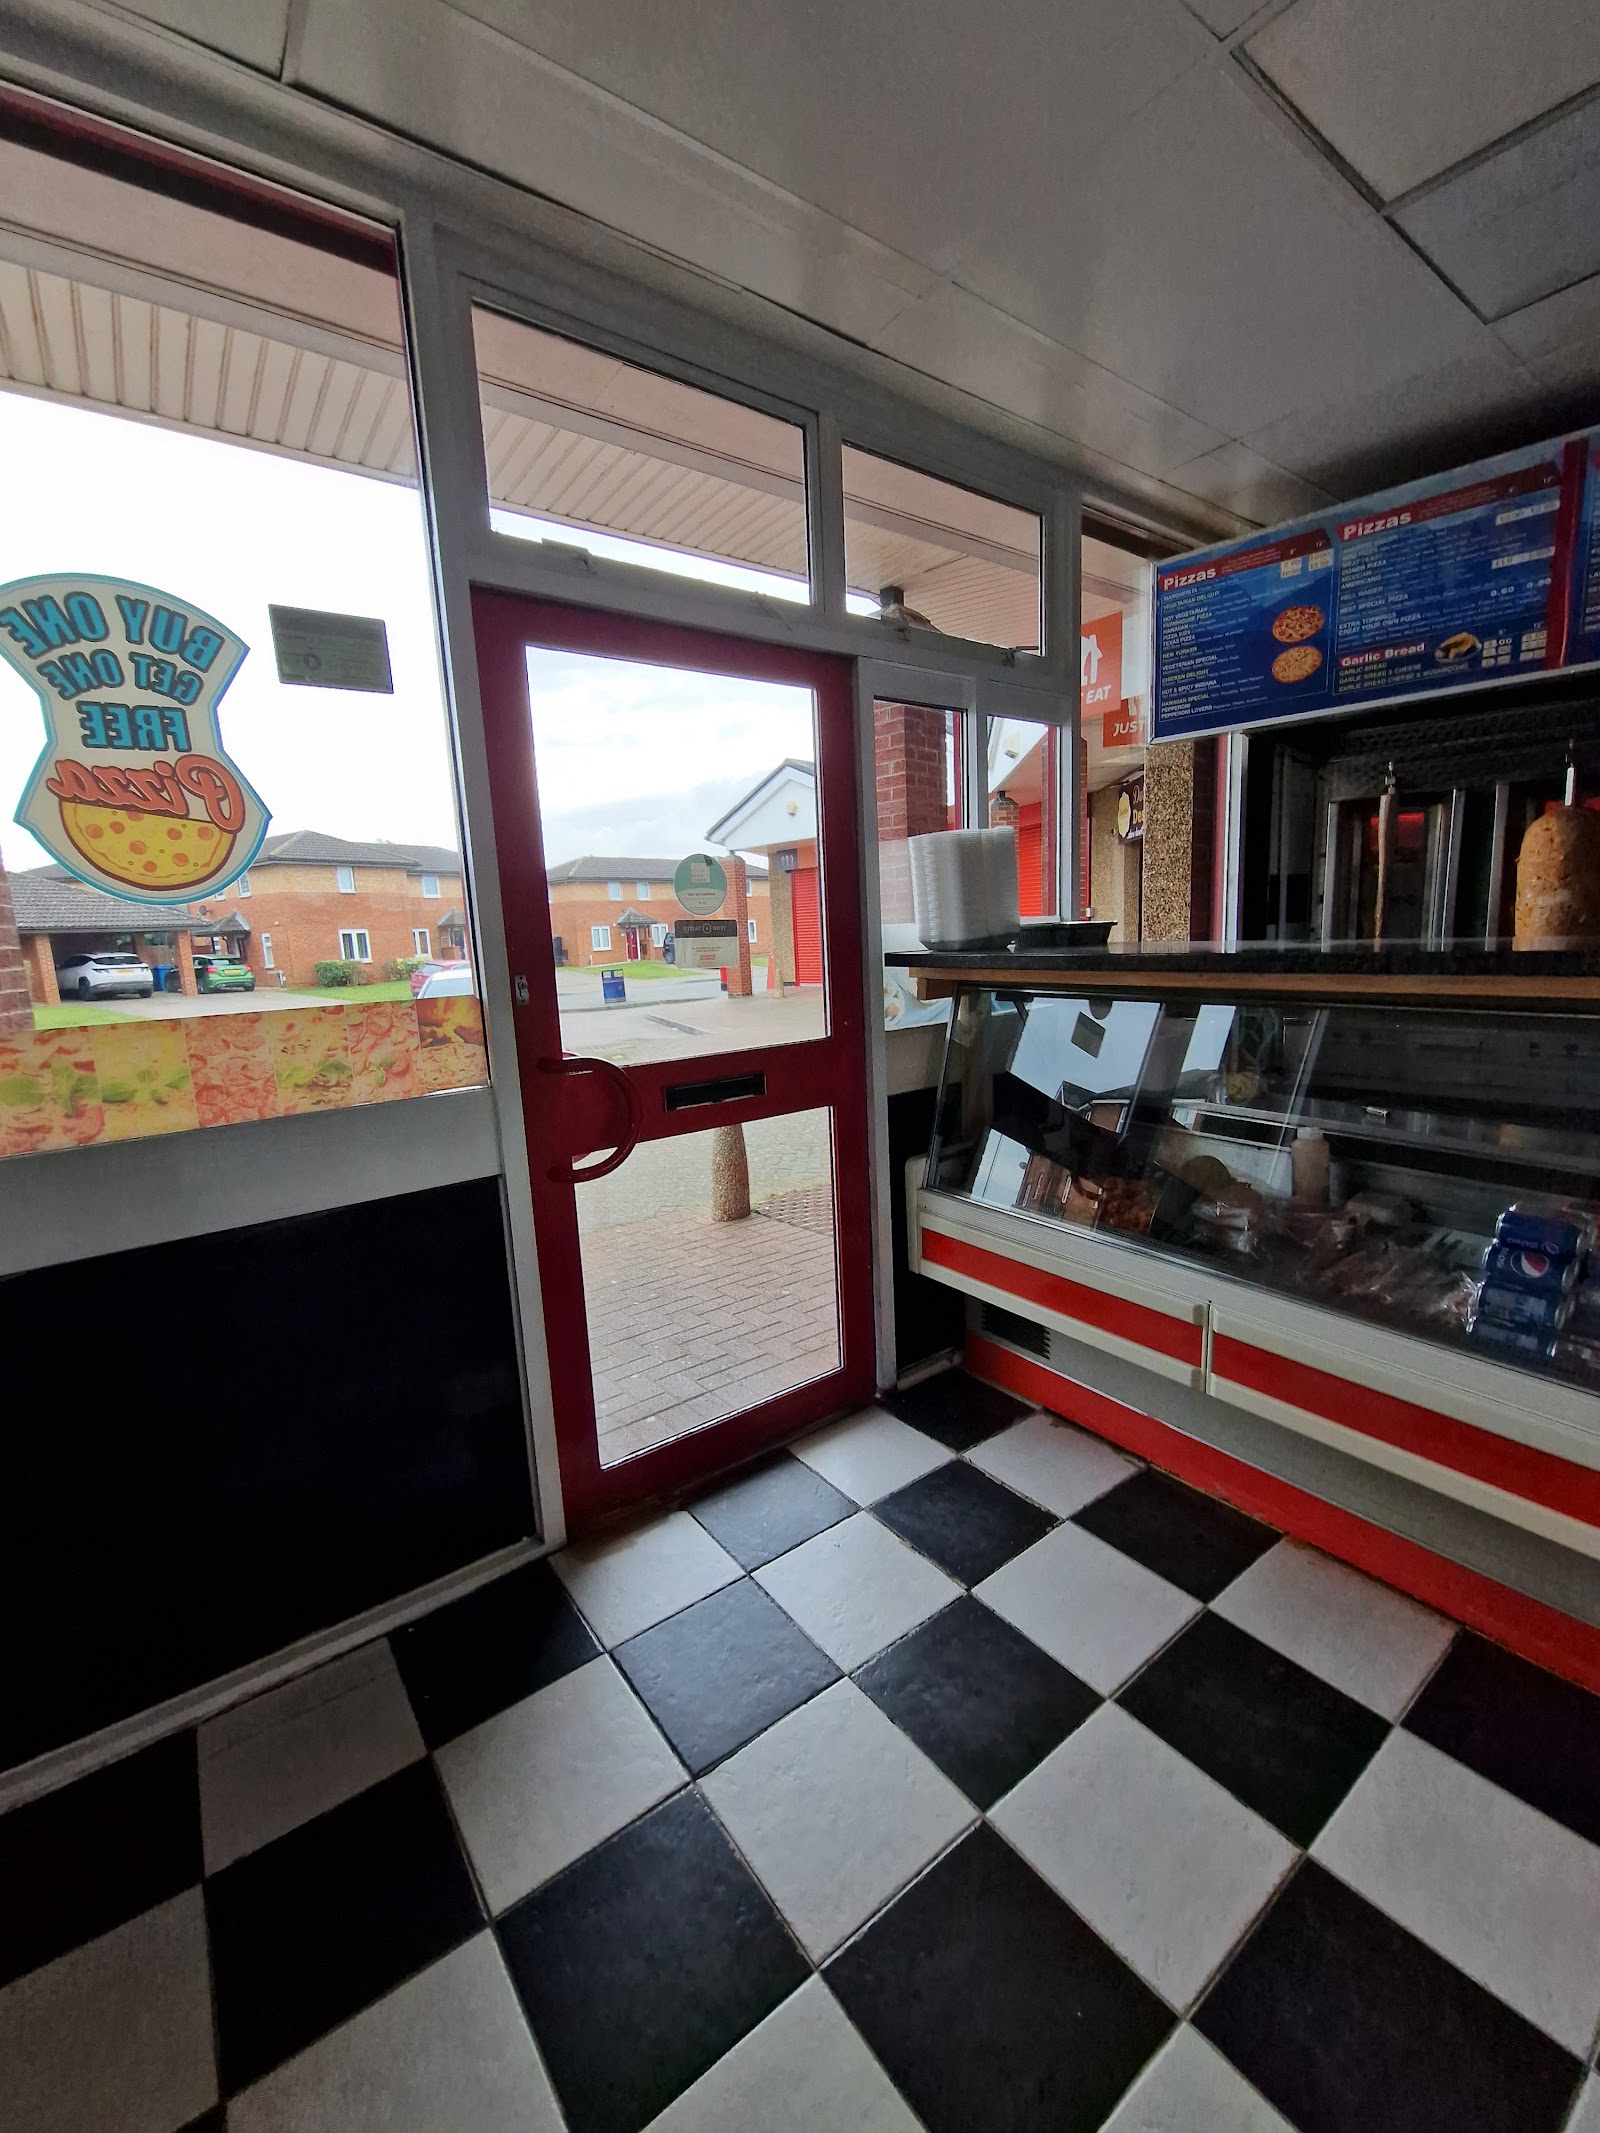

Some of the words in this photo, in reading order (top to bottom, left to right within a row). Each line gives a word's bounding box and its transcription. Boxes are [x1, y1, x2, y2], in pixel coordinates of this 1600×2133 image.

[1343, 512, 1411, 540] Pizzas
[1367, 559, 1386, 568] PIZZA
[1163, 568, 1216, 590] Pizzas
[1387, 592, 1408, 603] PIZZA
[1196, 611, 1212, 619] PIZZA
[1338, 620, 1360, 629] EXTRA
[1362, 621, 1380, 630] YOUR
[1382, 617, 1398, 626] OWN
[1163, 632, 1177, 640] PIZZA
[1163, 638, 1178, 646] TEXAS
[1180, 634, 1195, 642] PIZZA
[1195, 654, 1217, 663] SPECIAL
[1341, 651, 1380, 666] Garlic
[1385, 643, 1424, 657] Bread
[1339, 667, 1362, 676] GARLIC
[1364, 662, 1386, 671] BREAD
[1162, 674, 1185, 683] CHICKEN
[1186, 668, 1208, 677] DELIGHT
[1339, 675, 1361, 684] GARLIC
[1085, 685, 1111, 704] EAT
[1187, 692, 1210, 702] SPECIAL
[1161, 703, 1190, 712] PEPPERONI
[1161, 709, 1189, 718] PEPPERONI
[1191, 704, 1212, 713] LOVERS
[1112, 721, 1146, 737] JUST
